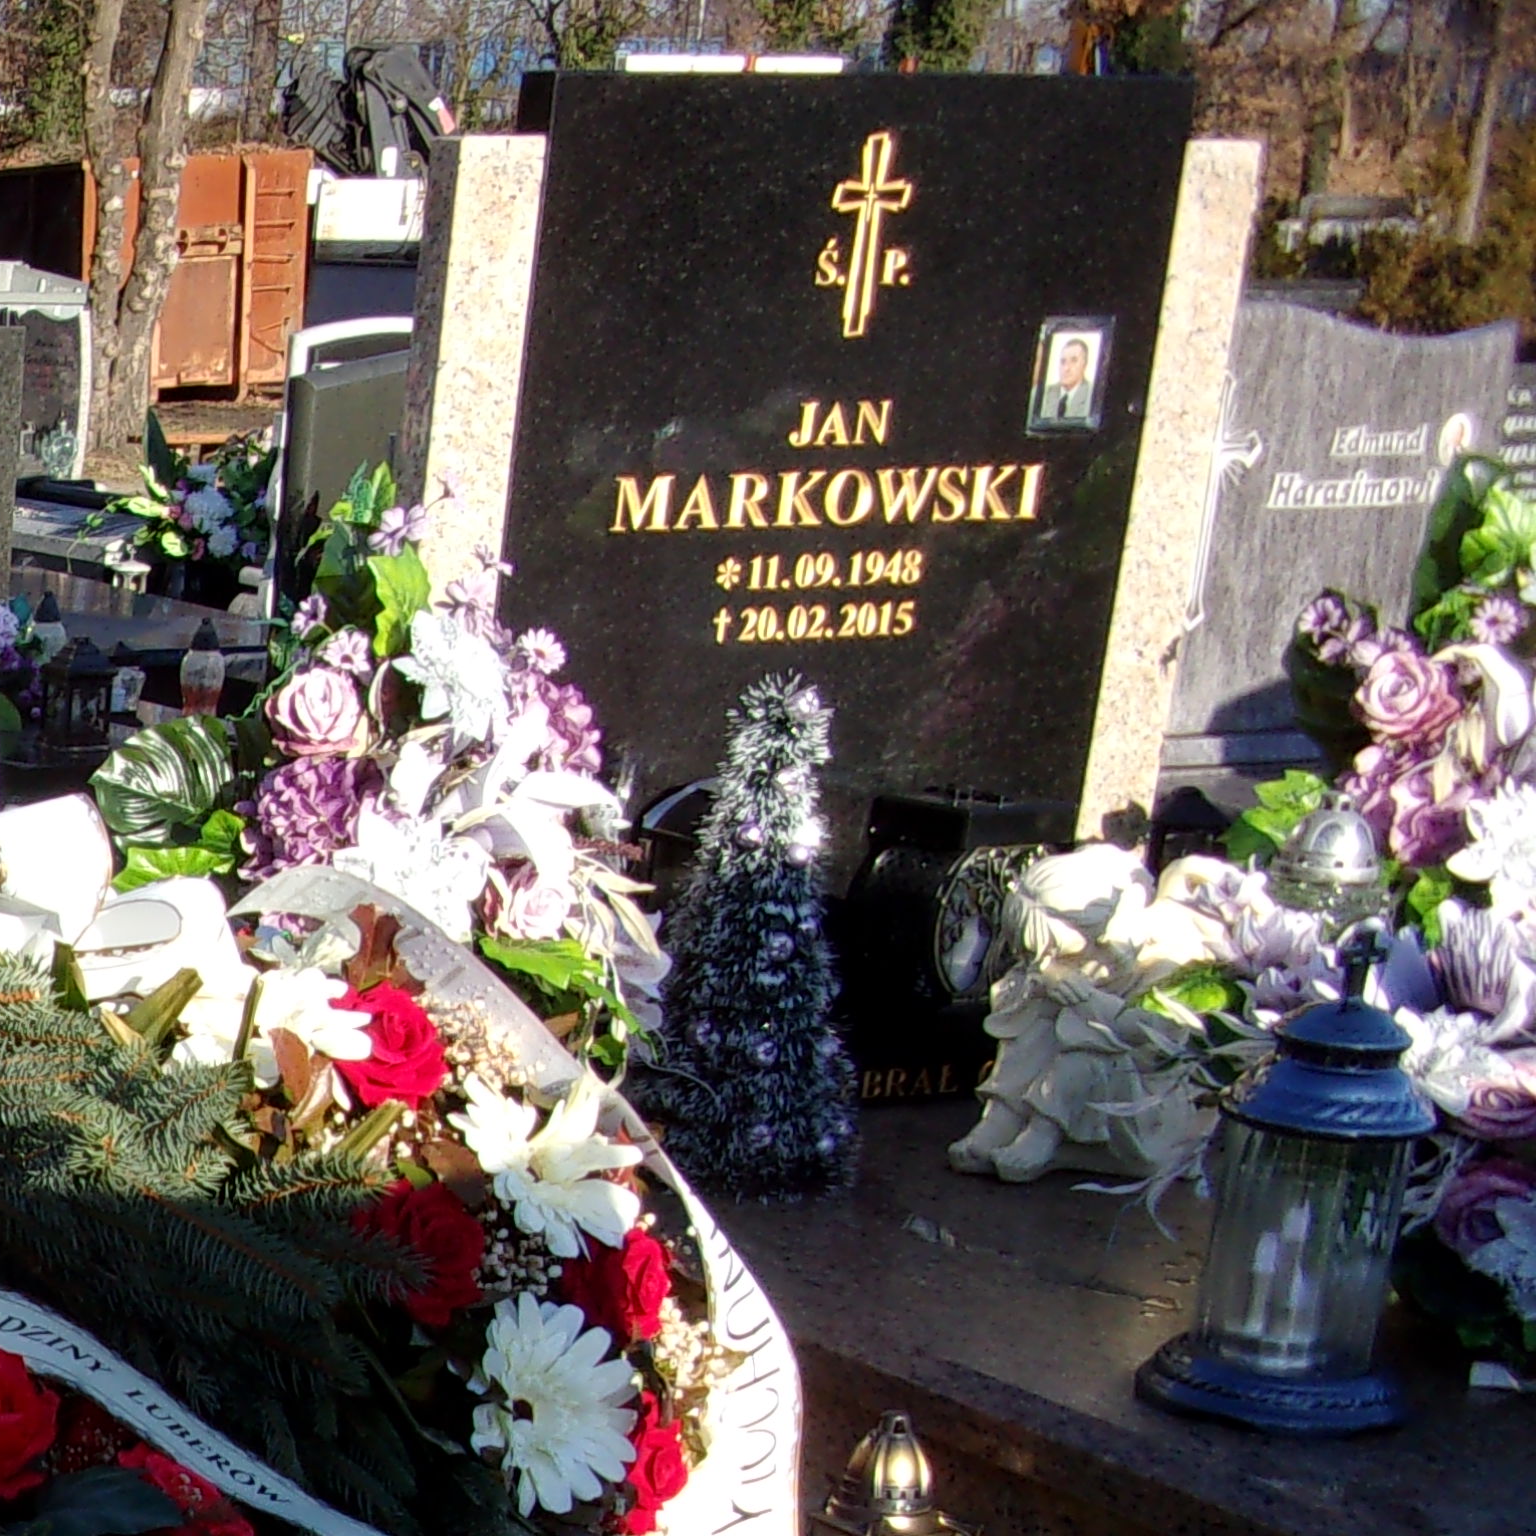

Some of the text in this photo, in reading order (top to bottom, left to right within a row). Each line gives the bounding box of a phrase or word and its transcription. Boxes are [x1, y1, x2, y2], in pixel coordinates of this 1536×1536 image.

[815, 238, 912, 286] Ś. P.
[788, 399, 893, 448] JAN
[1331, 425, 1427, 455] Edmund
[607, 462, 1046, 533] MARKOWSKI
[1268, 471, 1444, 508] Harasimowi
[125, 1386, 293, 1506] LUBERÓW
